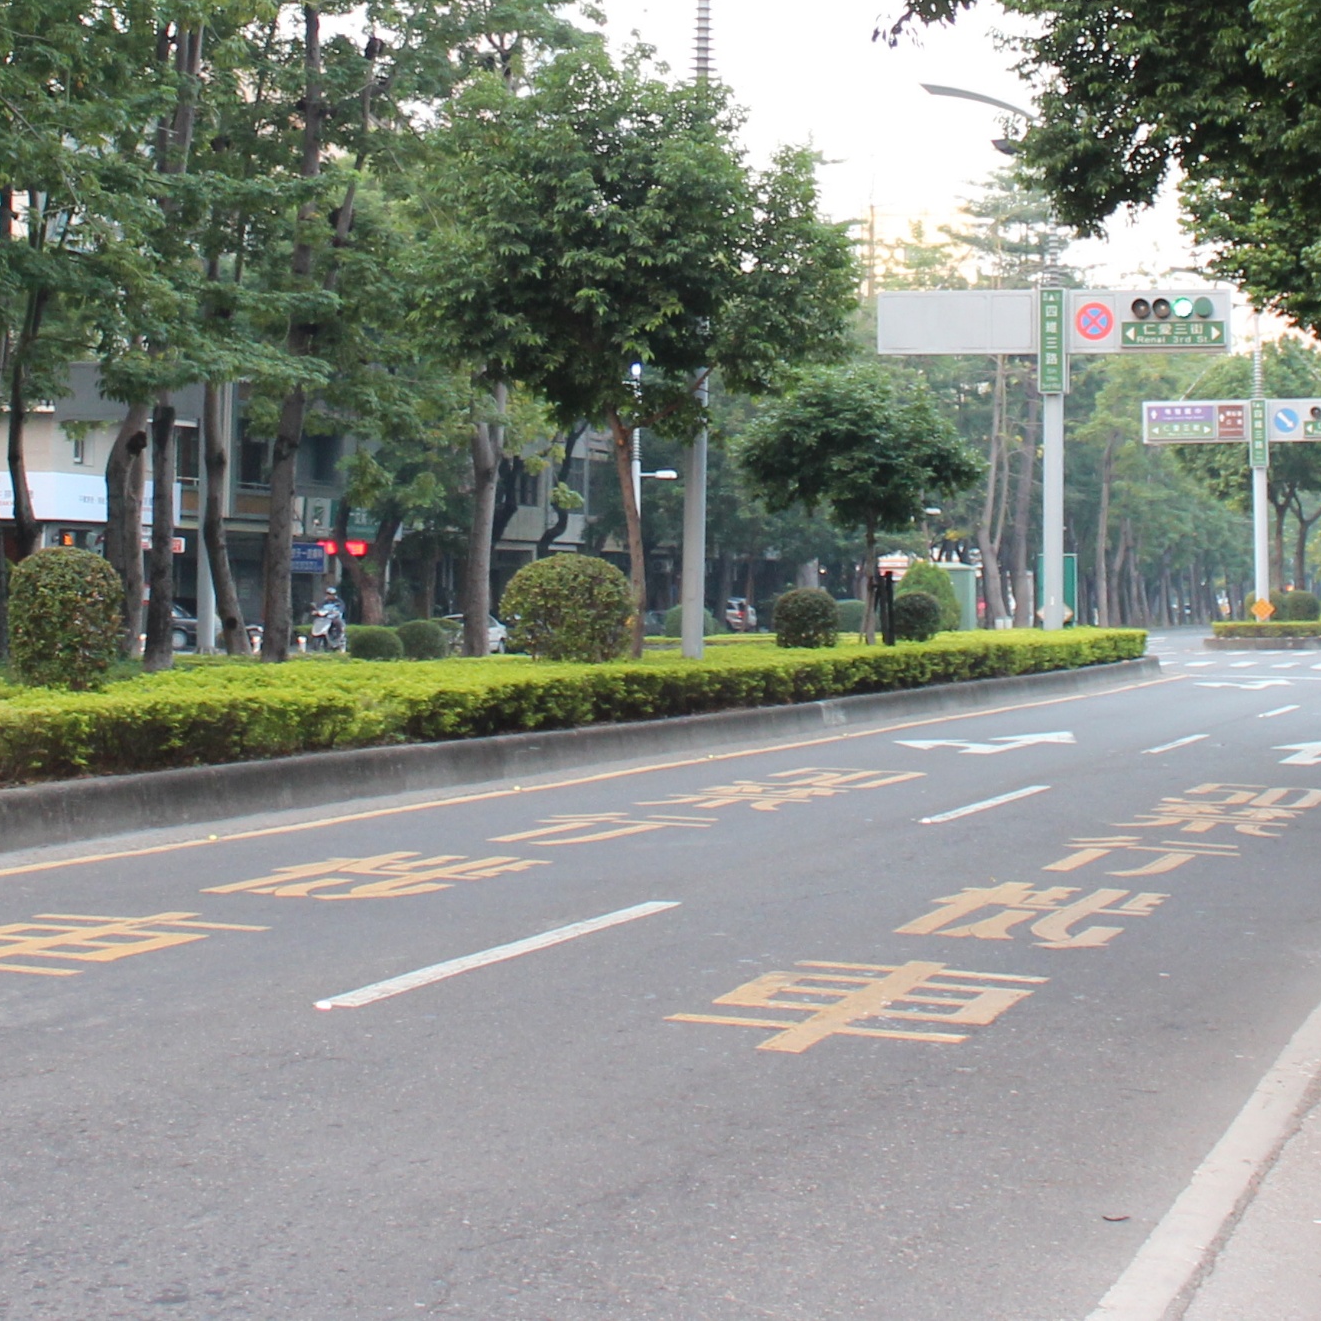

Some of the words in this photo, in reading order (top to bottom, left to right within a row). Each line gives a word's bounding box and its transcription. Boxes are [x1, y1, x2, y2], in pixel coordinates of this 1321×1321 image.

[1142, 322, 1205, 336] 仁愛三街
[1173, 335, 1192, 343] 3rd
[768, 766, 928, 790] 50
